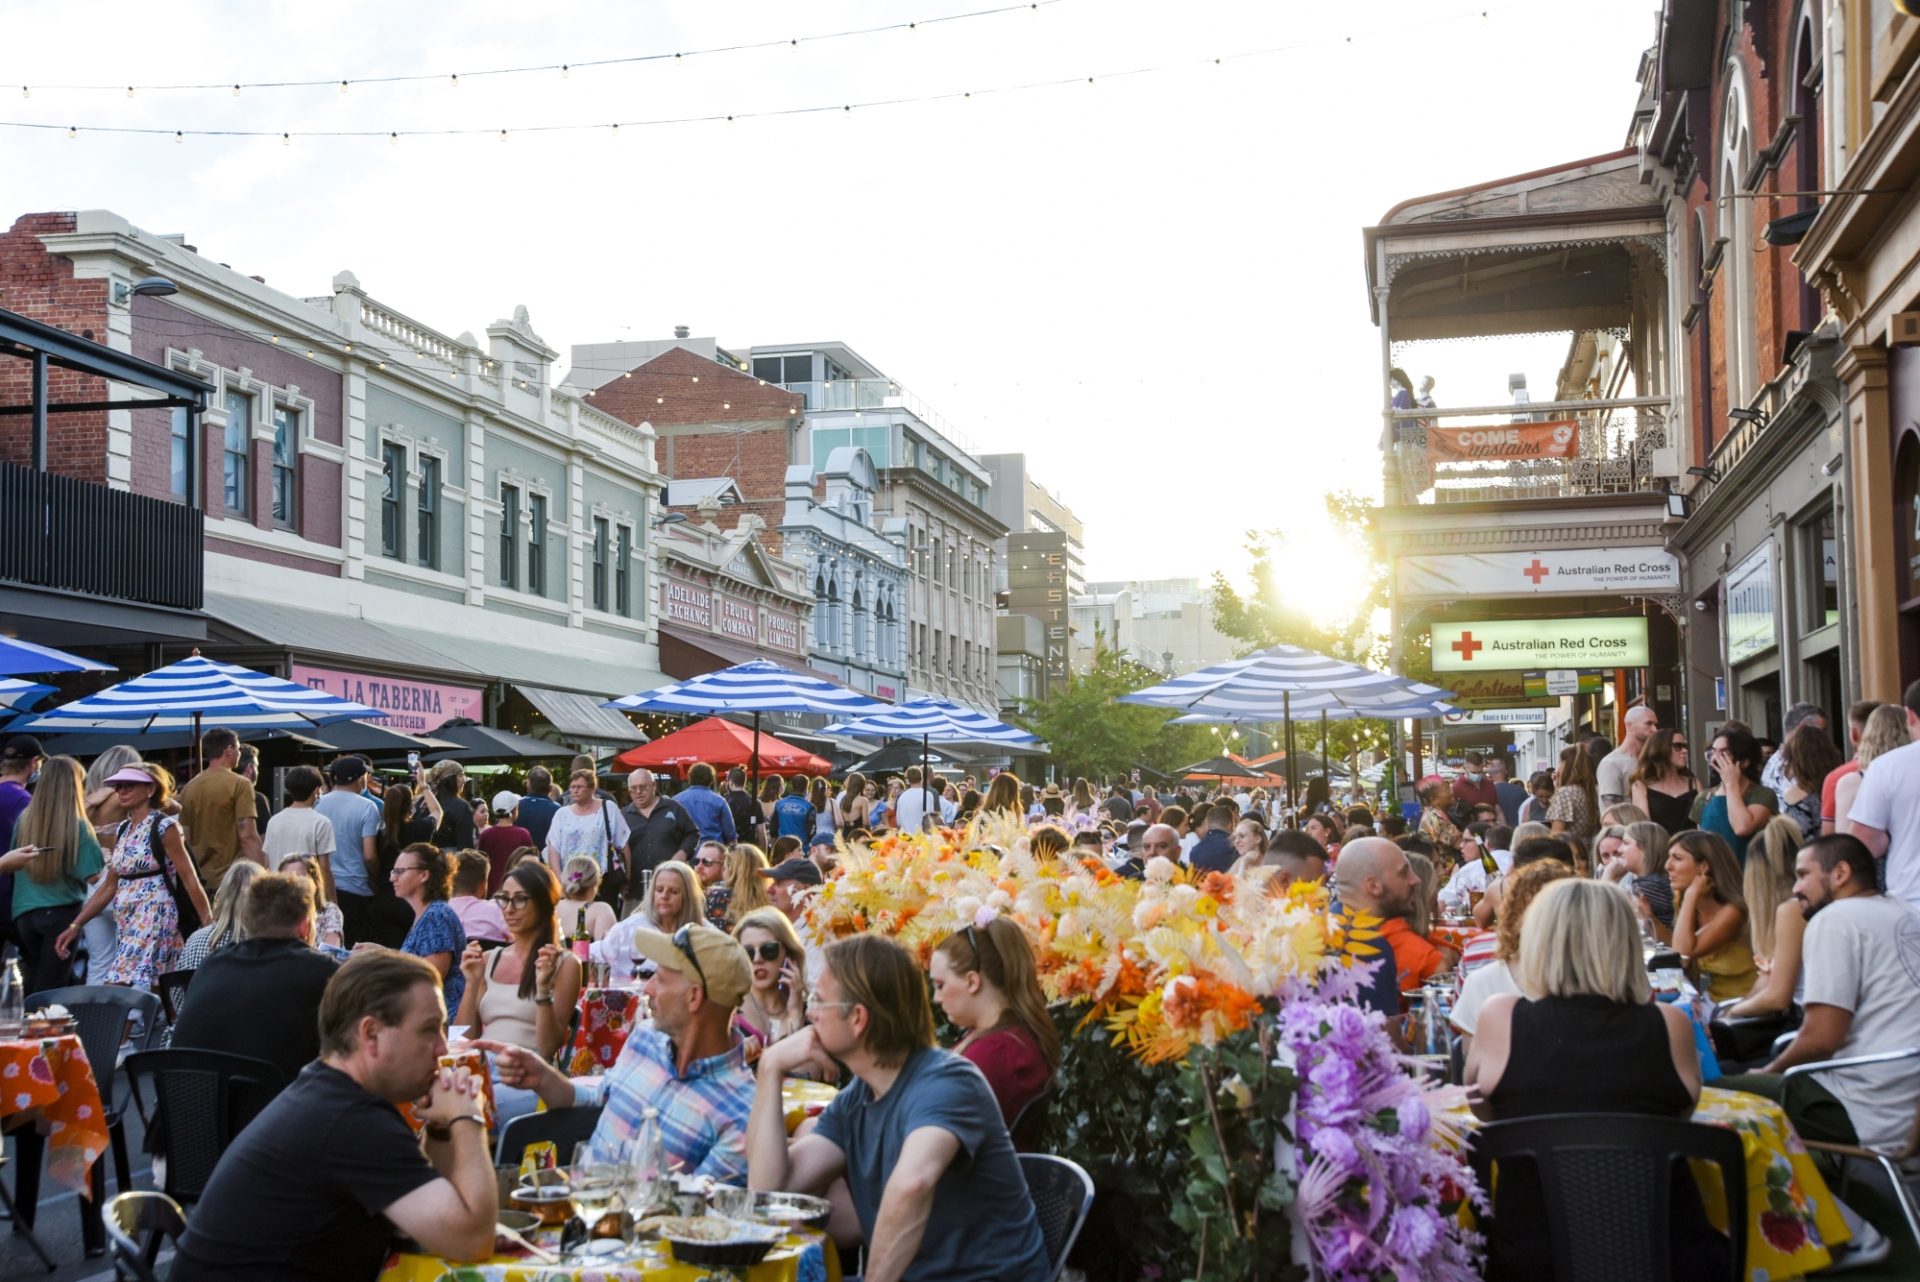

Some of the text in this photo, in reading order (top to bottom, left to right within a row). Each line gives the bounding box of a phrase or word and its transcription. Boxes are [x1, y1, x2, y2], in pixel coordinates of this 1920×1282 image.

[1457, 429, 1520, 447] COME
[1468, 441, 1541, 458] upstairs
[1557, 563, 1671, 576] Australian Red Cross
[669, 585, 710, 609] ADELAIDE
[669, 603, 710, 626] EXCHANGE
[725, 601, 754, 622] FRUIT &
[722, 617, 756, 639] COMPANY
[767, 615, 797, 635] PRODUCE
[768, 631, 796, 649] LIMITED
[1492, 636, 1627, 651] Australian Red Cross
[1590, 650, 1627, 658] HUMANITY
[343, 679, 366, 706] LA
[369, 682, 442, 714] TABERNA
[389, 713, 426, 730] KITCHEN
